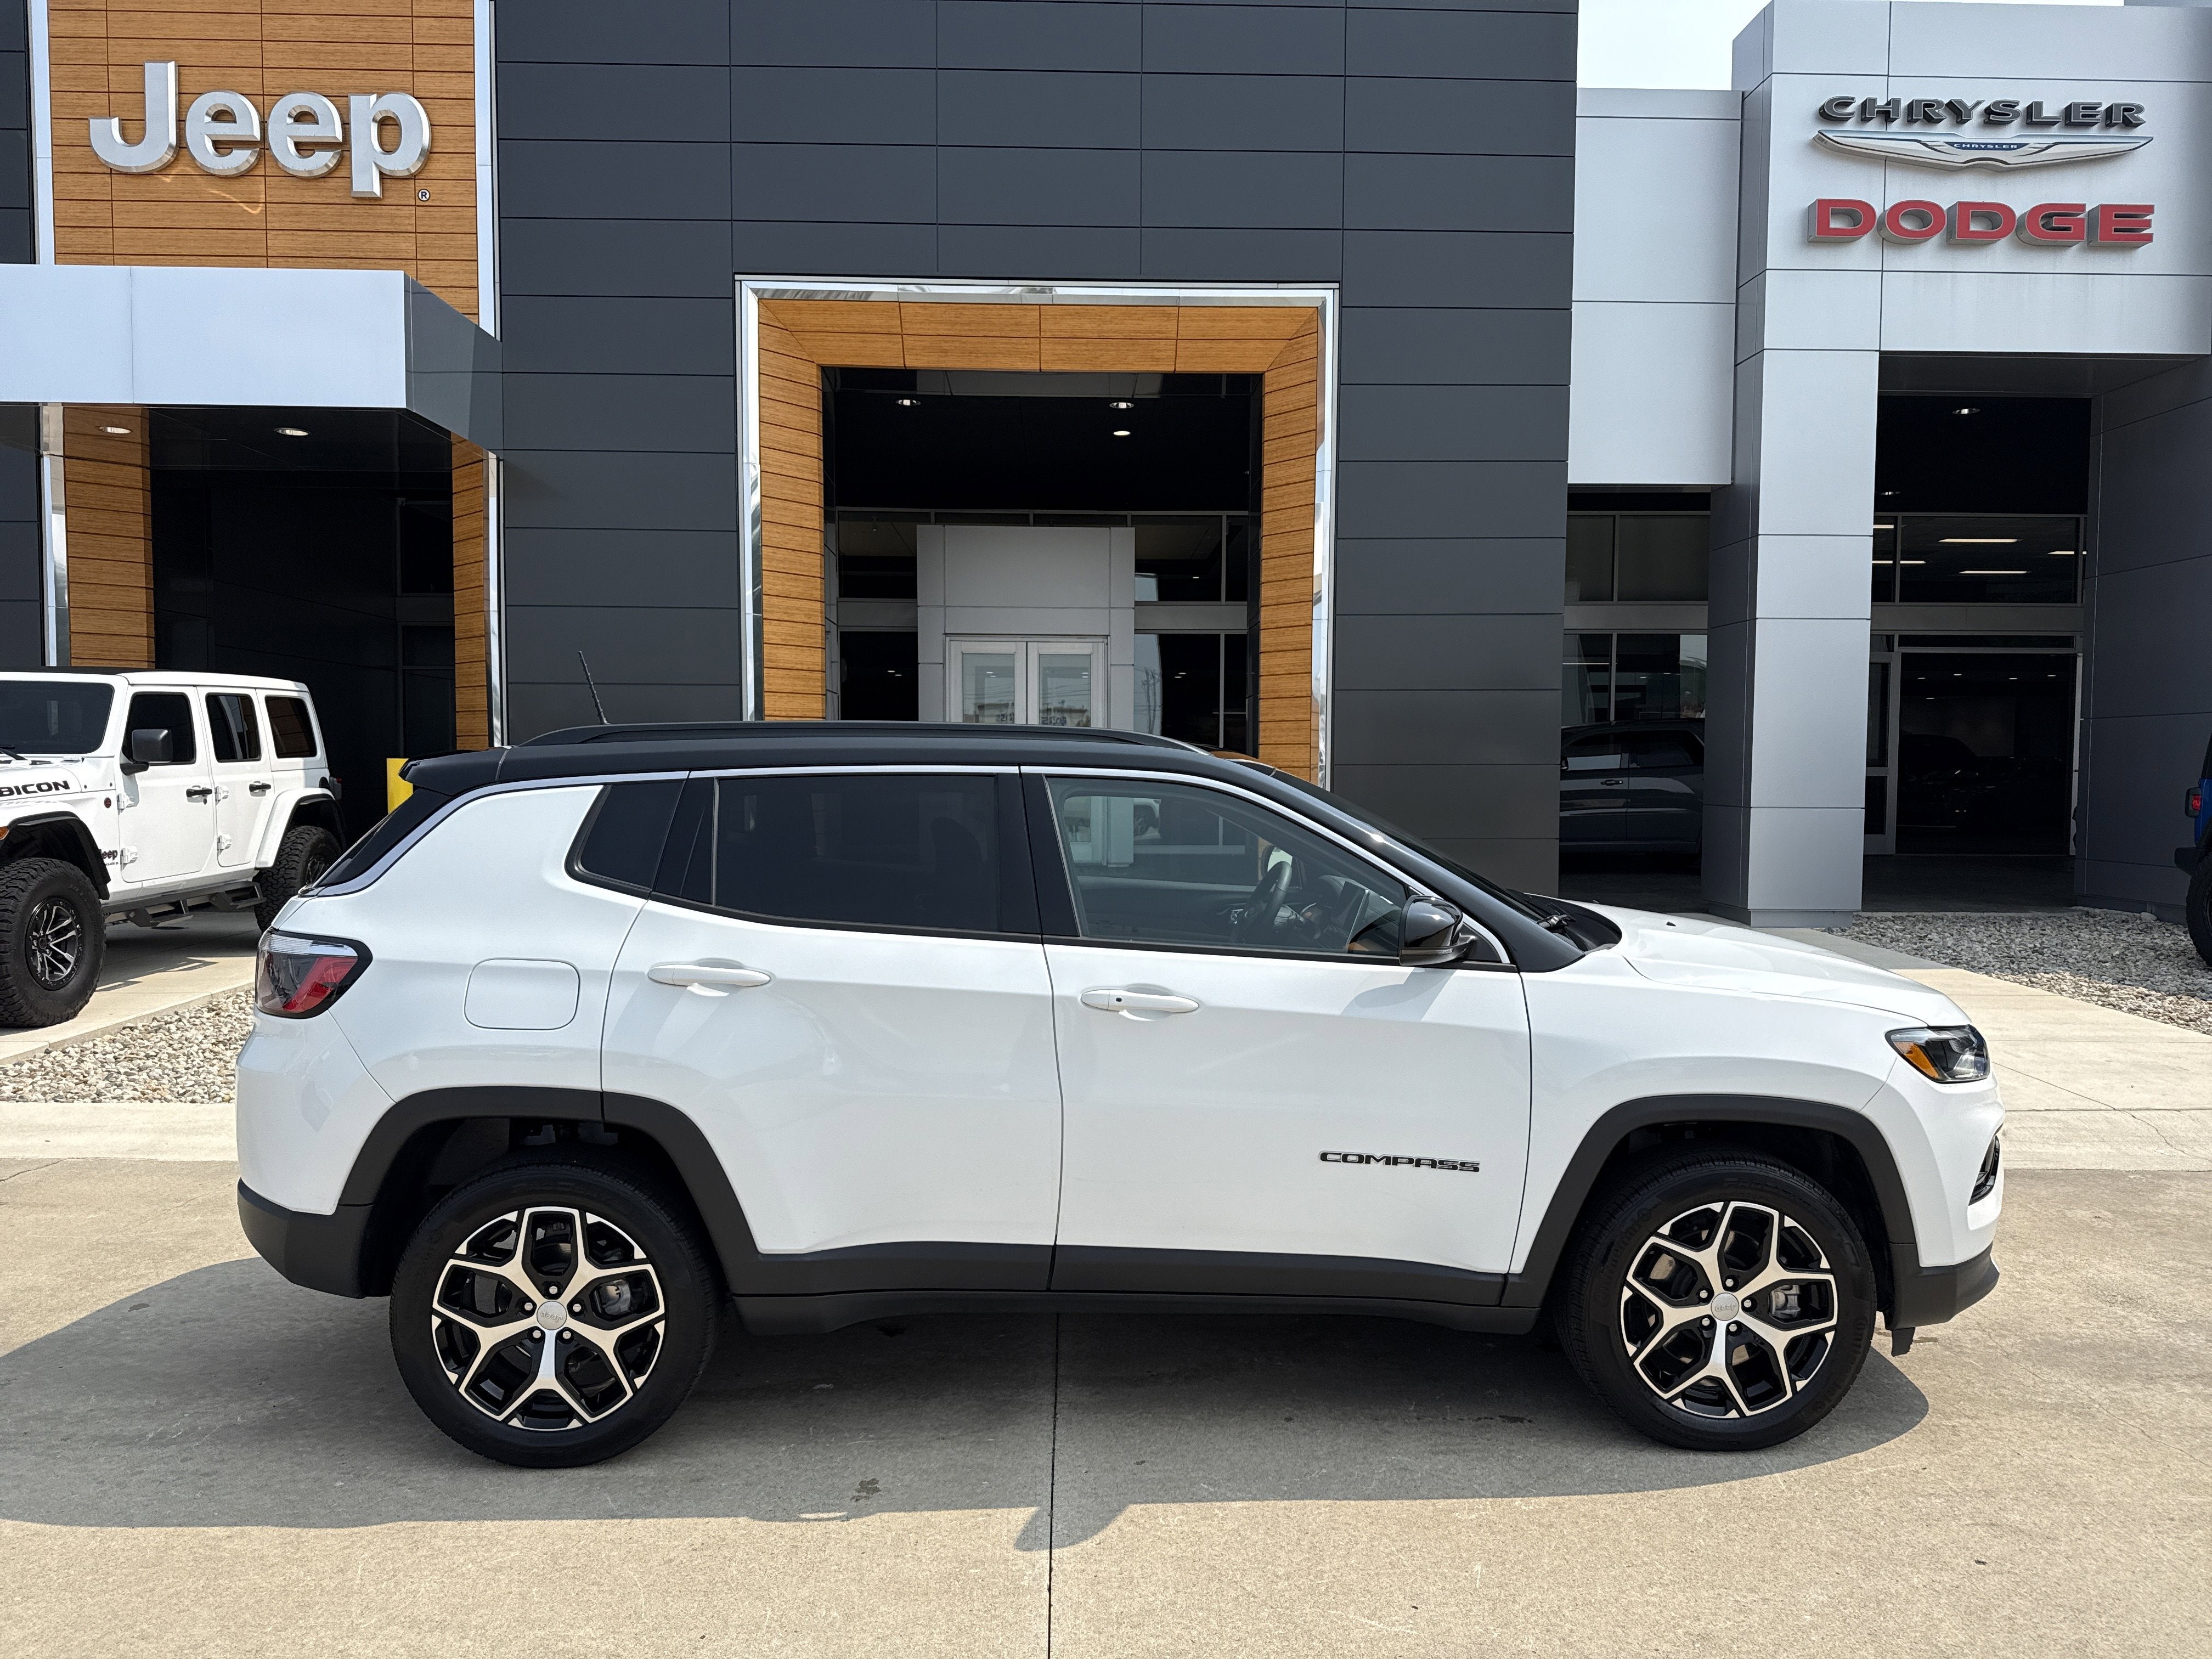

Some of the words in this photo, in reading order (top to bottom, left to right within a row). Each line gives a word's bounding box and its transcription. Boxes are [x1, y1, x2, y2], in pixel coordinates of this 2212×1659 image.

[89, 60, 432, 199] Jeep
[1819, 96, 2146, 127] CHRYSLER
[1808, 199, 2155, 247] DODGE
[1319, 1150, 1480, 1172] COMPASS
